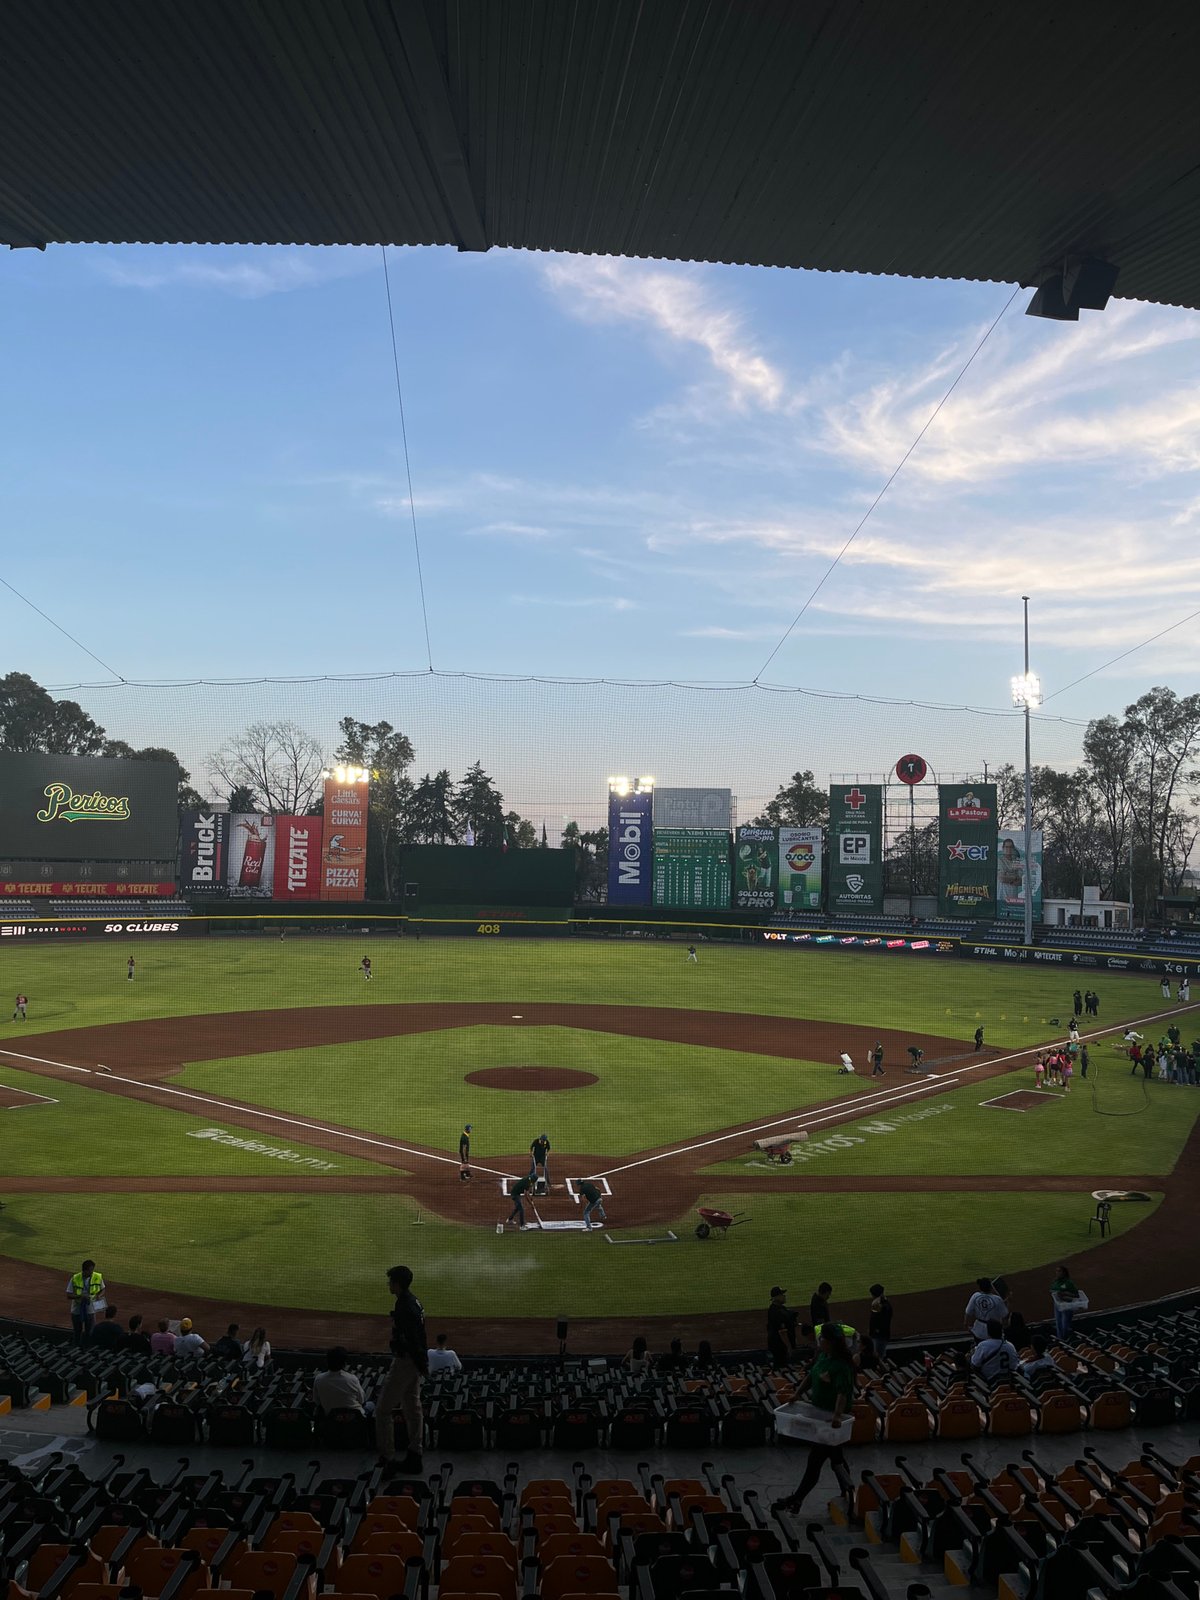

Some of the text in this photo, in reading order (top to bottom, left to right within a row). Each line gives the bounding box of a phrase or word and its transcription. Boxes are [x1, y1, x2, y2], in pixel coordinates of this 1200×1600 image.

[337, 789, 357, 797] Little
[37, 783, 131, 822] Pericos
[331, 796, 360, 804] Caesars
[192, 813, 215, 881] Bruck
[618, 812, 641, 884] Mobil
[843, 837, 867, 853] EP
[244, 856, 262, 867] Red
[288, 826, 309, 892] TECATE
[326, 868, 359, 877] PIZZA!
[326, 878, 358, 887] PIZZA!
[18, 884, 53, 894] TECATE
[75, 884, 107, 894] TECATE
[128, 884, 158, 894] TECATE
[104, 923, 179, 932] 50 CLUBES
[477, 924, 500, 934] 408
[763, 932, 788, 940] VOLT
[973, 947, 998, 955] STIHL
[1042, 952, 1062, 961] TECATE
[210, 1133, 340, 1170] caliente.mx
[999, 1351, 1010, 1369] 2
